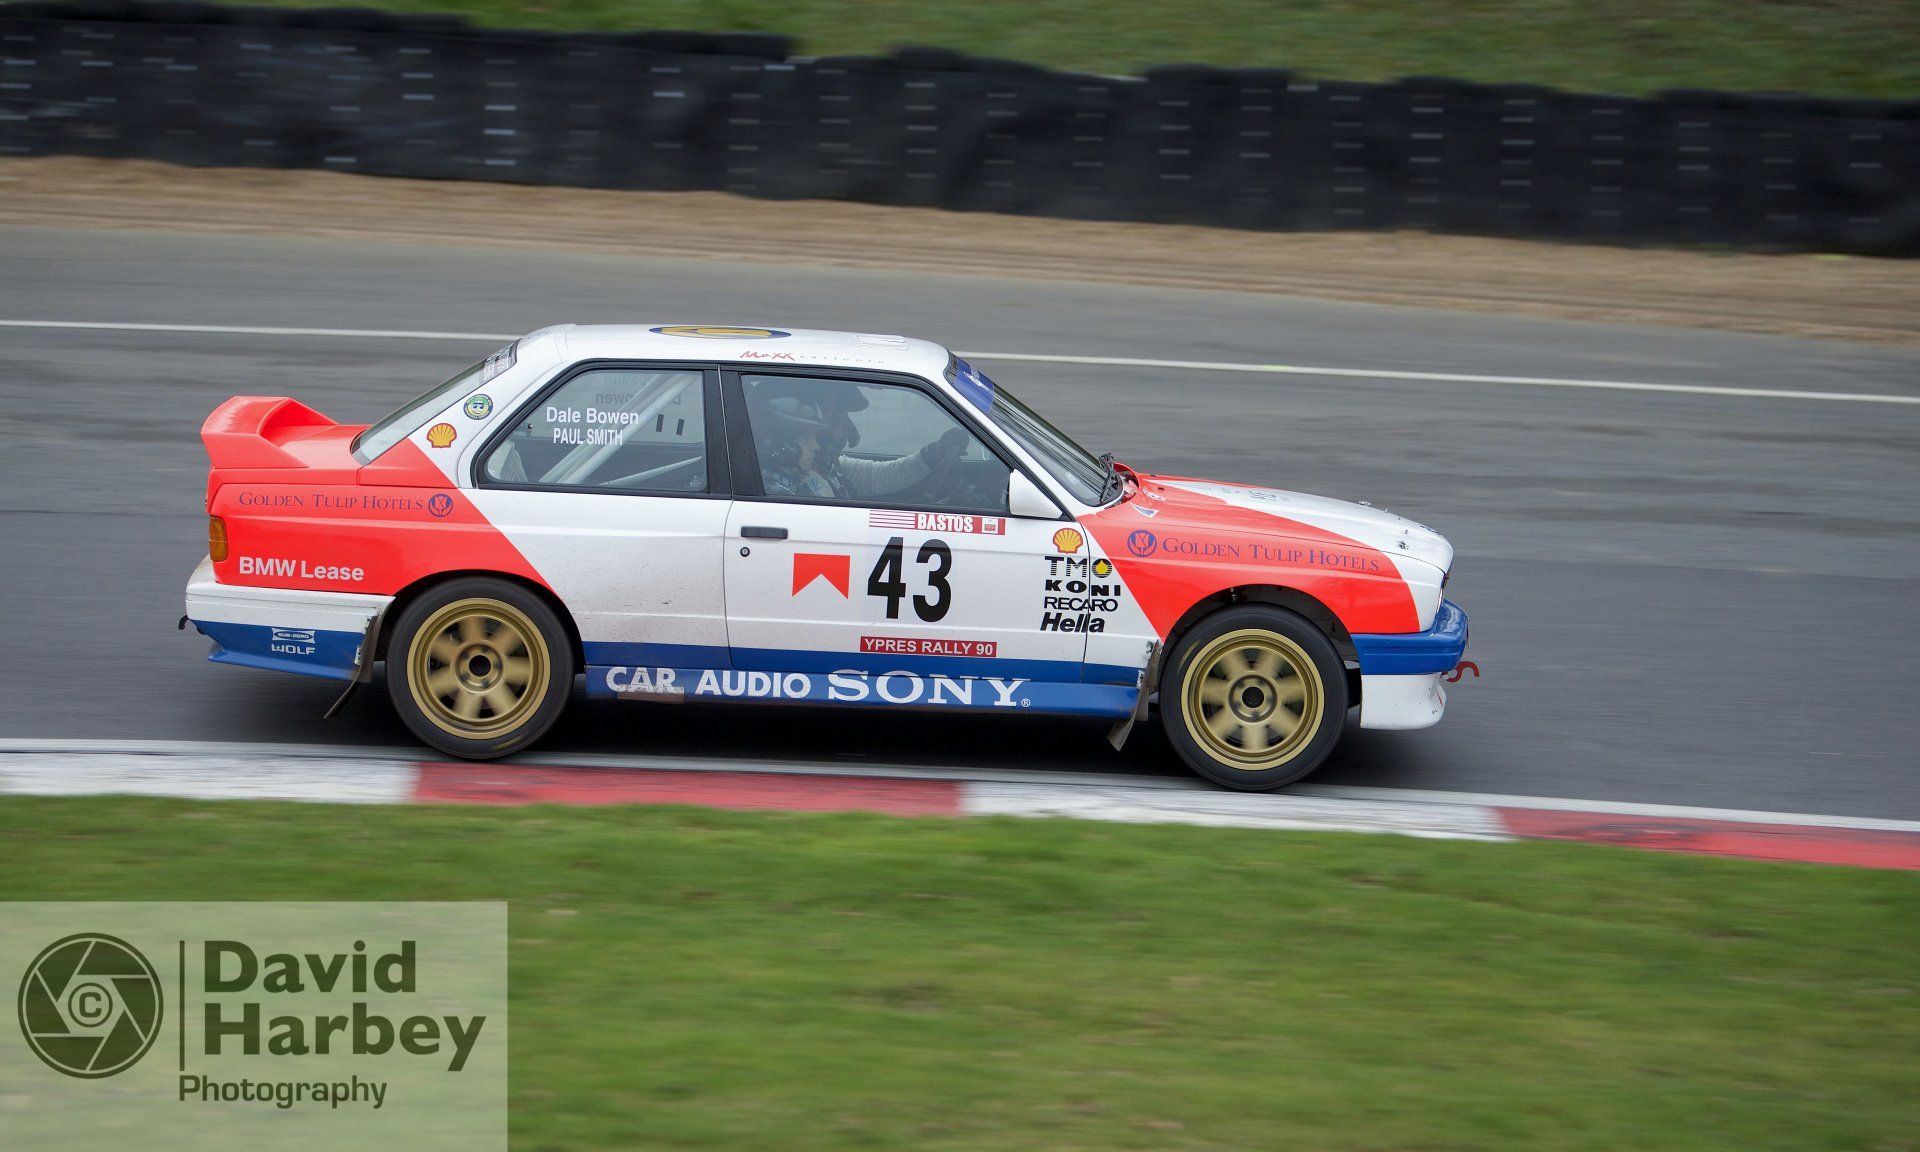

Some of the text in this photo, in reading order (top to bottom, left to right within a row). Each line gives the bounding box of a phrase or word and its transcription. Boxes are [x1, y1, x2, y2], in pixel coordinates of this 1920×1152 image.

[546, 406, 639, 425] Dale Bowen
[553, 427, 623, 446] PAUL SMITH
[239, 492, 423, 511] GOLDEN TULIP HOTELS
[917, 513, 974, 532] BASTOS
[1162, 537, 1379, 572] GOLDEN TULIP HOTELS
[239, 556, 364, 581] BMW Lease
[867, 536, 952, 623] 43
[1045, 579, 1121, 597] KONI
[1044, 596, 1118, 612] RECARO
[1040, 612, 1105, 633] Hella
[271, 643, 315, 656] WOLF
[864, 638, 993, 656] YPRES RALLY 90
[605, 666, 682, 694] CAR
[694, 669, 812, 699] AUDIO
